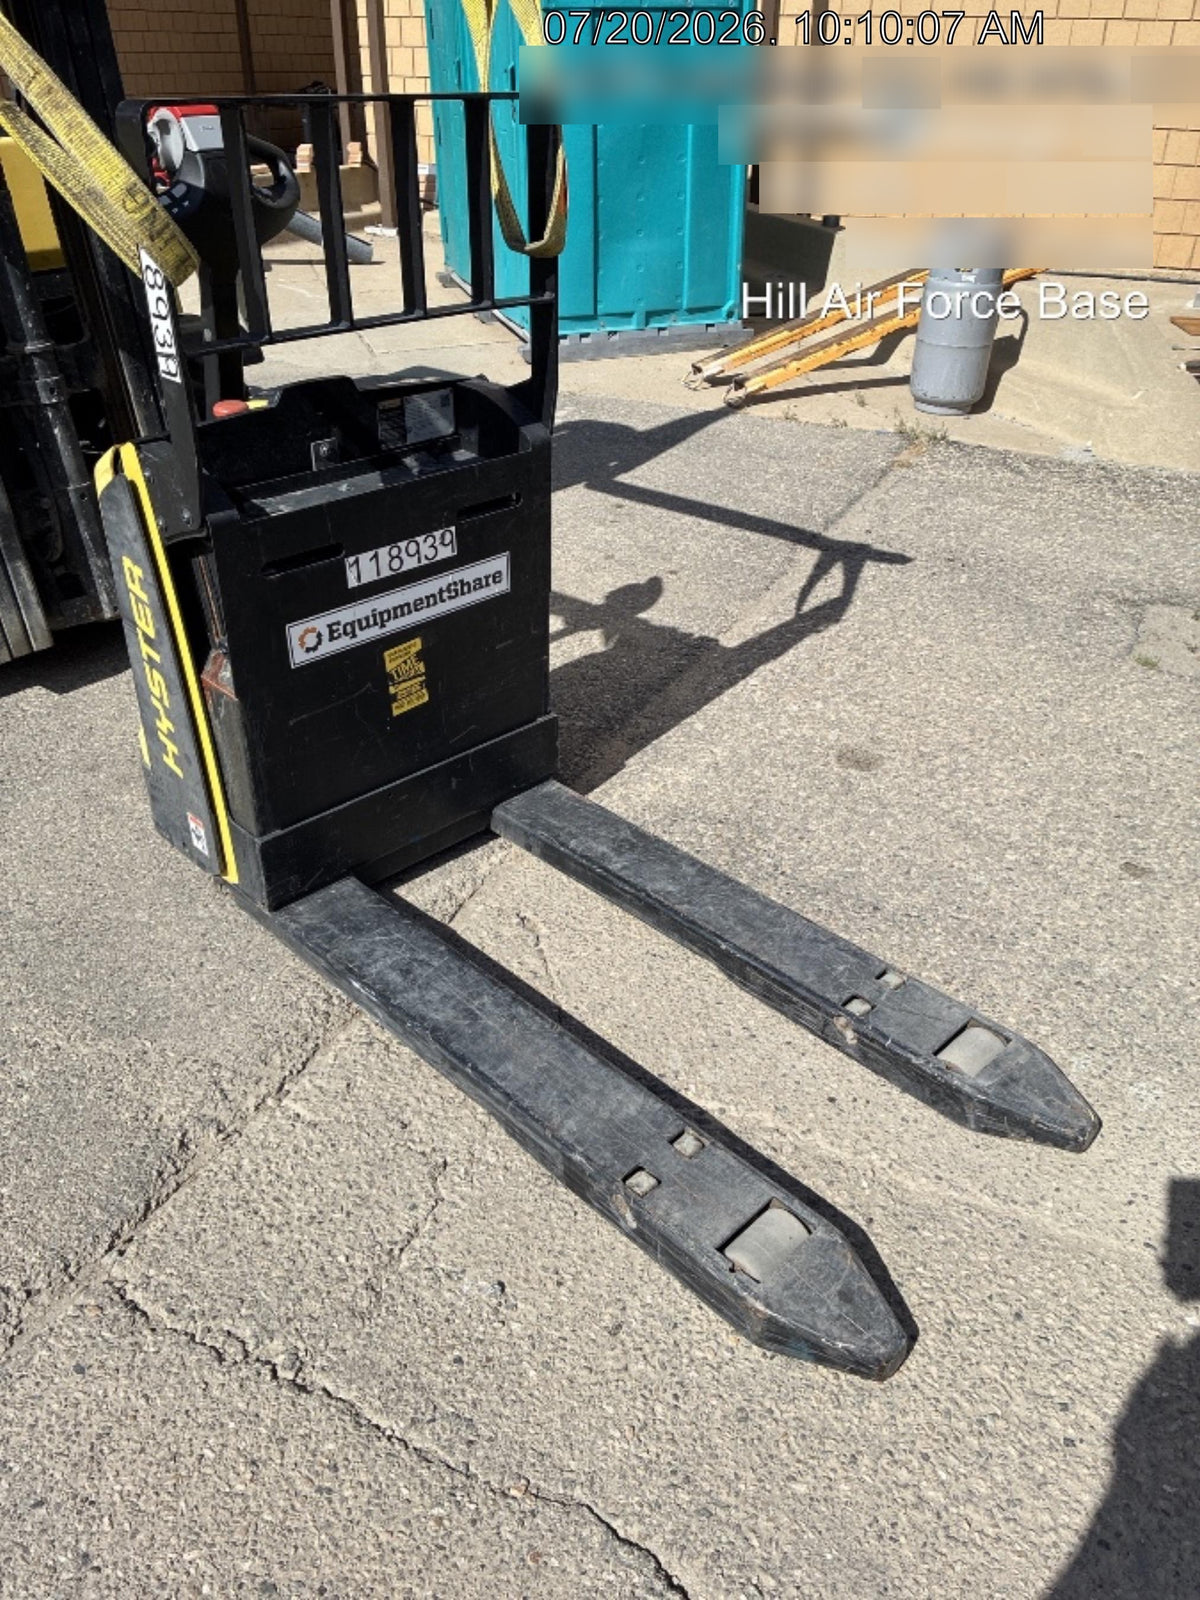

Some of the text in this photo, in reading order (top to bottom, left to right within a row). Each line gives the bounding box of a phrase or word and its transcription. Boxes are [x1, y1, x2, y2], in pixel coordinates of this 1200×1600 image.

[347, 529, 457, 584] 118939
[327, 569, 503, 643] EquipmentShare
[121, 555, 184, 779] HYSTER
